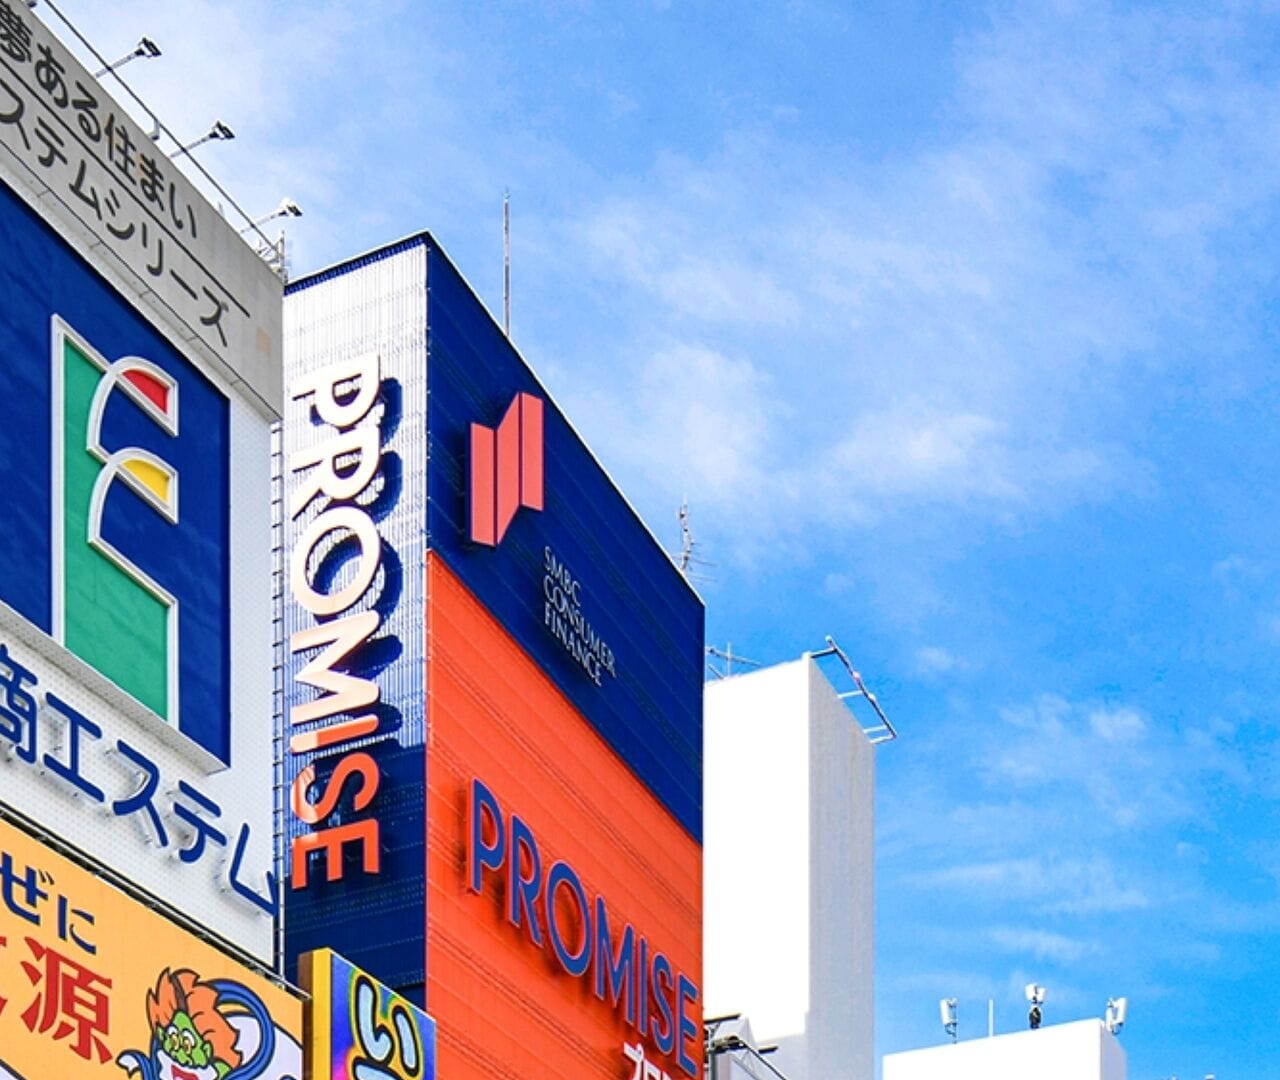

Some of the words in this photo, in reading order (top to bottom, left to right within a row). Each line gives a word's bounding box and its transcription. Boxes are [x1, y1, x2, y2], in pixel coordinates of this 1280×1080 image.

[291, 354, 380, 889] PROMISE
[544, 575, 616, 678] CONSUMER
[545, 546, 581, 607] SMBC
[544, 607, 602, 686] FINANCE
[467, 777, 698, 1079] PROMISE
